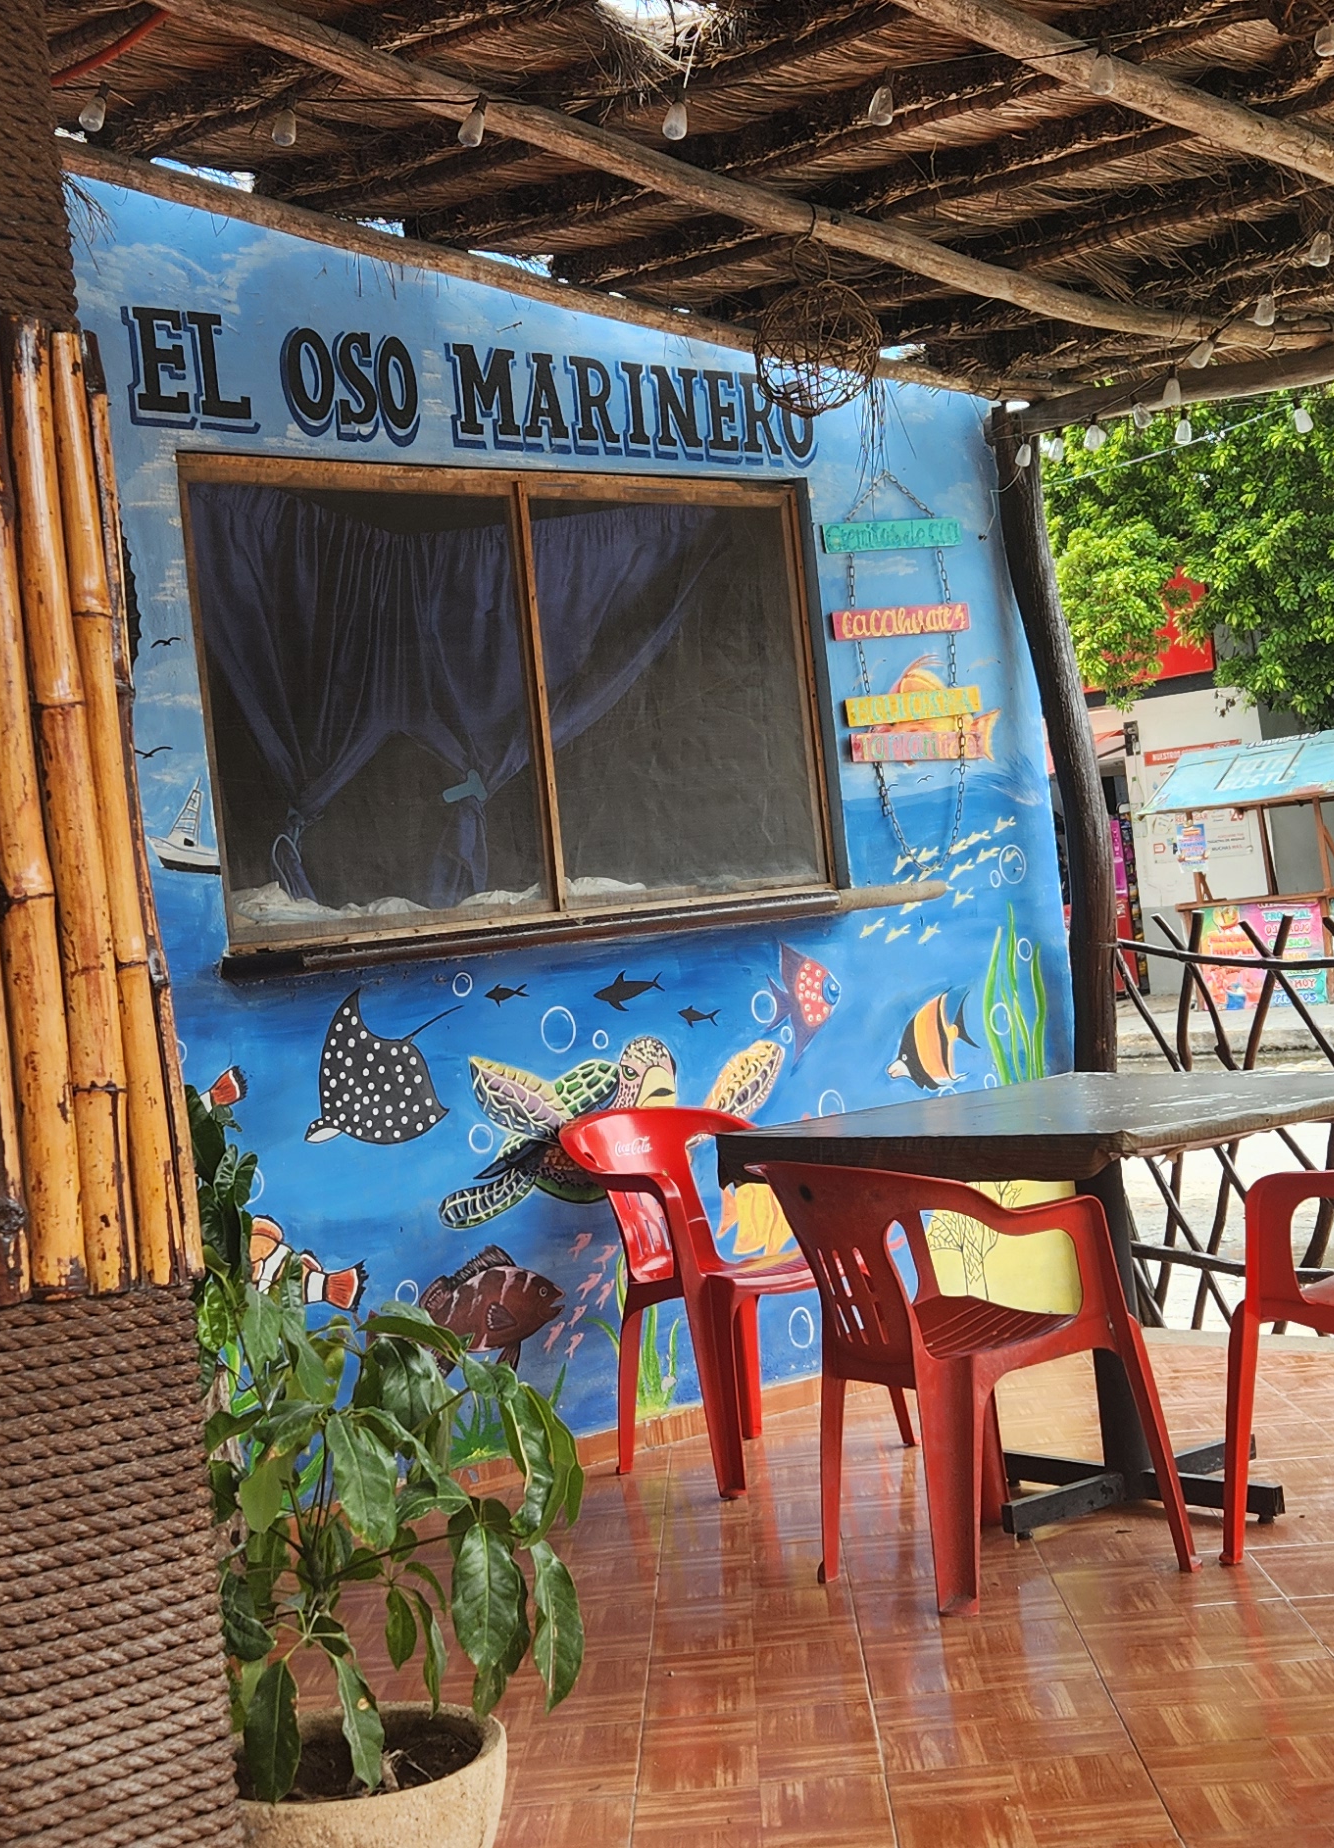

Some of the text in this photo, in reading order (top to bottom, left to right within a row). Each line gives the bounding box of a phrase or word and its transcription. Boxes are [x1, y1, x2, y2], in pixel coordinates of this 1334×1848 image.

[121, 306, 819, 468] EL OSO MARINERO
